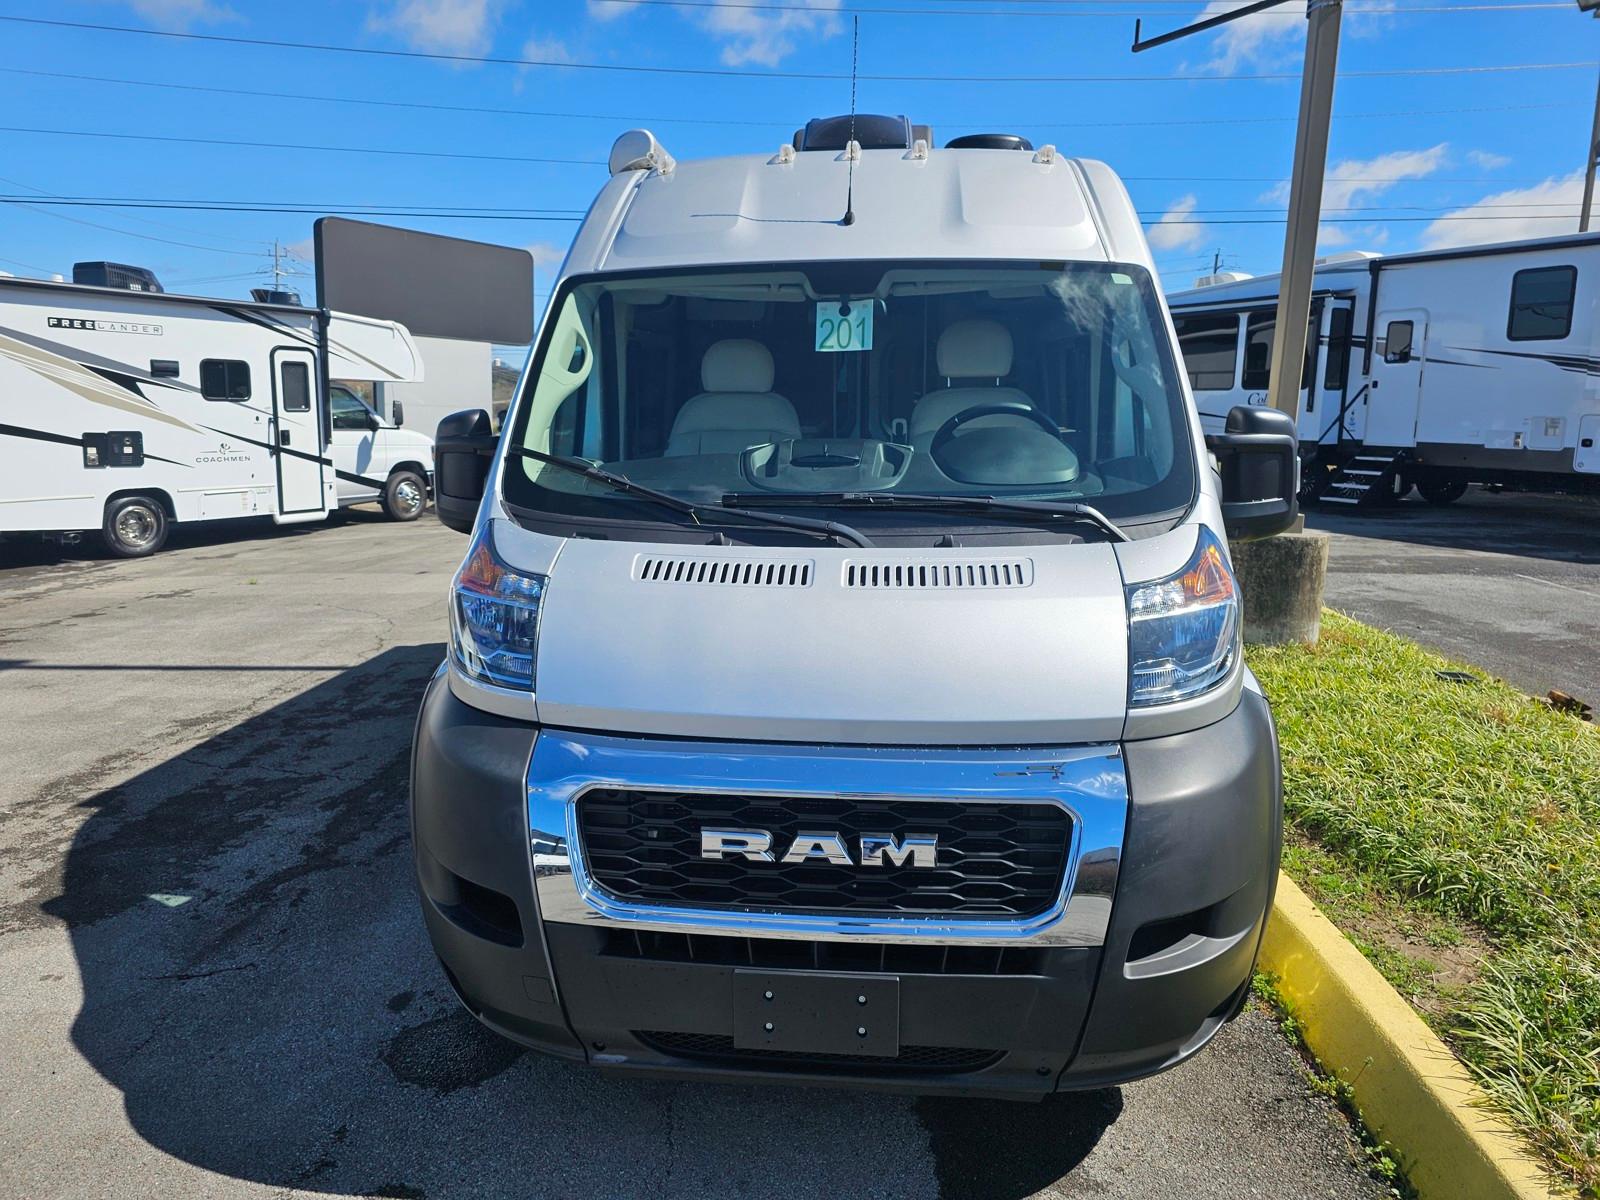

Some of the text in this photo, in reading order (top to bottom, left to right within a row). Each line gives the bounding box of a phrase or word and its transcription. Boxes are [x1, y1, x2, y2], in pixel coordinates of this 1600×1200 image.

[48, 318, 161, 333] FREELANDER
[819, 317, 866, 349] 201
[195, 455, 251, 463] COACHMEN
[700, 826, 939, 867] RAM
